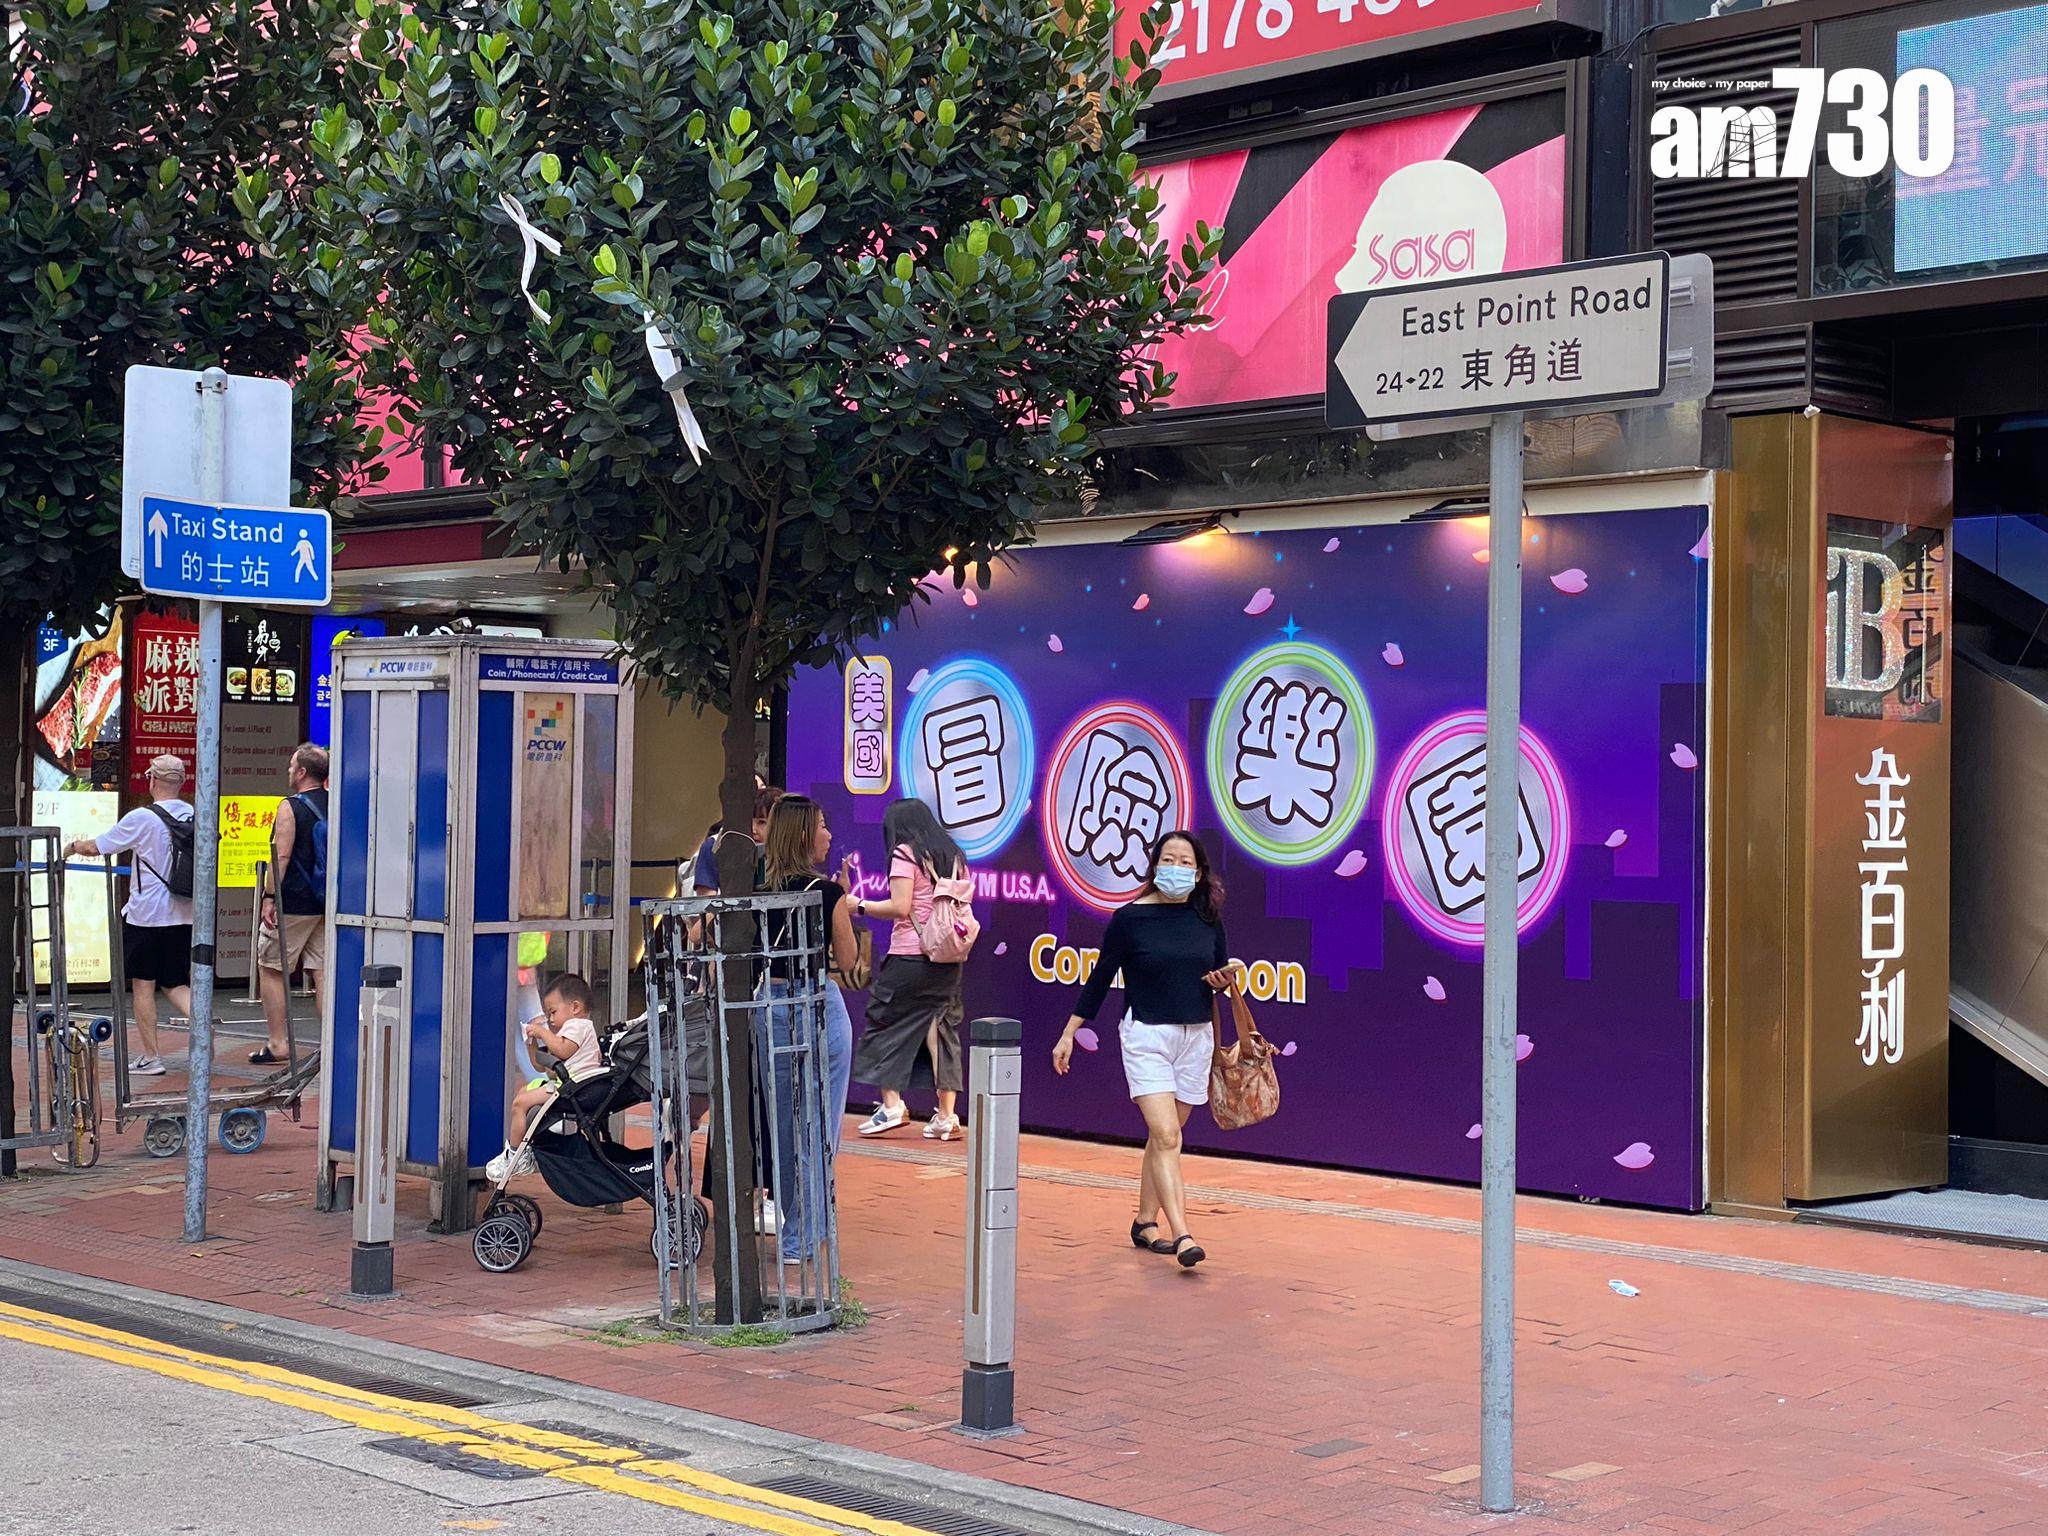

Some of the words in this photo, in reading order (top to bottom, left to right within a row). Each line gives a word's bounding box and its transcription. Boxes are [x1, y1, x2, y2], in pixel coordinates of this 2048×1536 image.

[1402, 302, 1465, 337] East
[1478, 290, 1557, 328] Point
[1571, 277, 1651, 317] Road
[1460, 337, 1582, 392] 東角道
[1376, 372, 1403, 395] 24
[1418, 367, 1444, 391] 22
[172, 513, 205, 538] Taxi
[212, 517, 283, 543] Stand
[181, 550, 270, 588] 的士站
[43, 638, 59, 651] 3F
[380, 662, 406, 673] PCCW
[588, 673, 608, 681] Card
[527, 740, 566, 751] PCCW
[1003, 873, 1056, 901] U.S.A.
[1854, 746, 1911, 1067] 金百利
[1213, 957, 1307, 1004] oon
